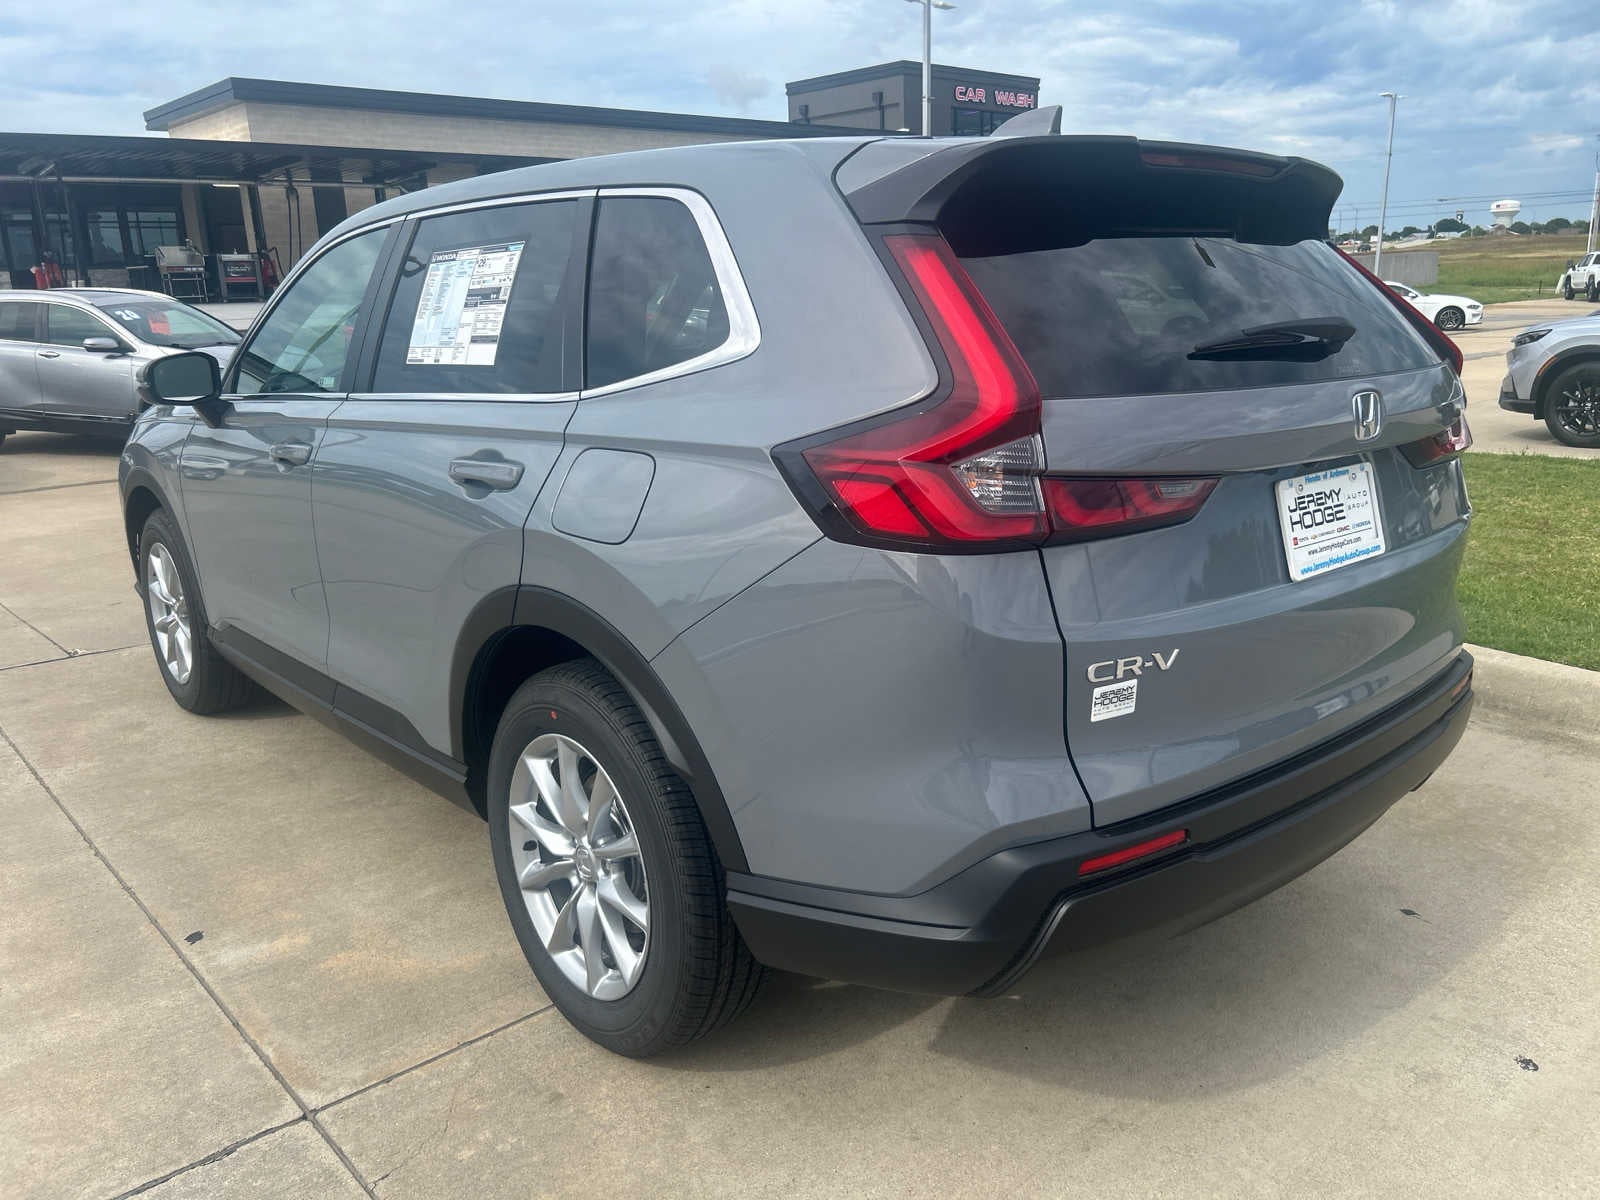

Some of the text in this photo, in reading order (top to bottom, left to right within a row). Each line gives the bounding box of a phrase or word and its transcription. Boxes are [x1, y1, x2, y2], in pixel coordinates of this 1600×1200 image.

[955, 86, 1035, 108] CAR WASH
[1288, 488, 1341, 513] JEREMY
[1347, 490, 1368, 501] AUTO
[1290, 503, 1346, 532] HODGE
[1337, 525, 1350, 533] GMC
[1087, 648, 1180, 683] CR-V
[1094, 685, 1135, 700] JEREMY
[1094, 691, 1135, 708] HODGE
